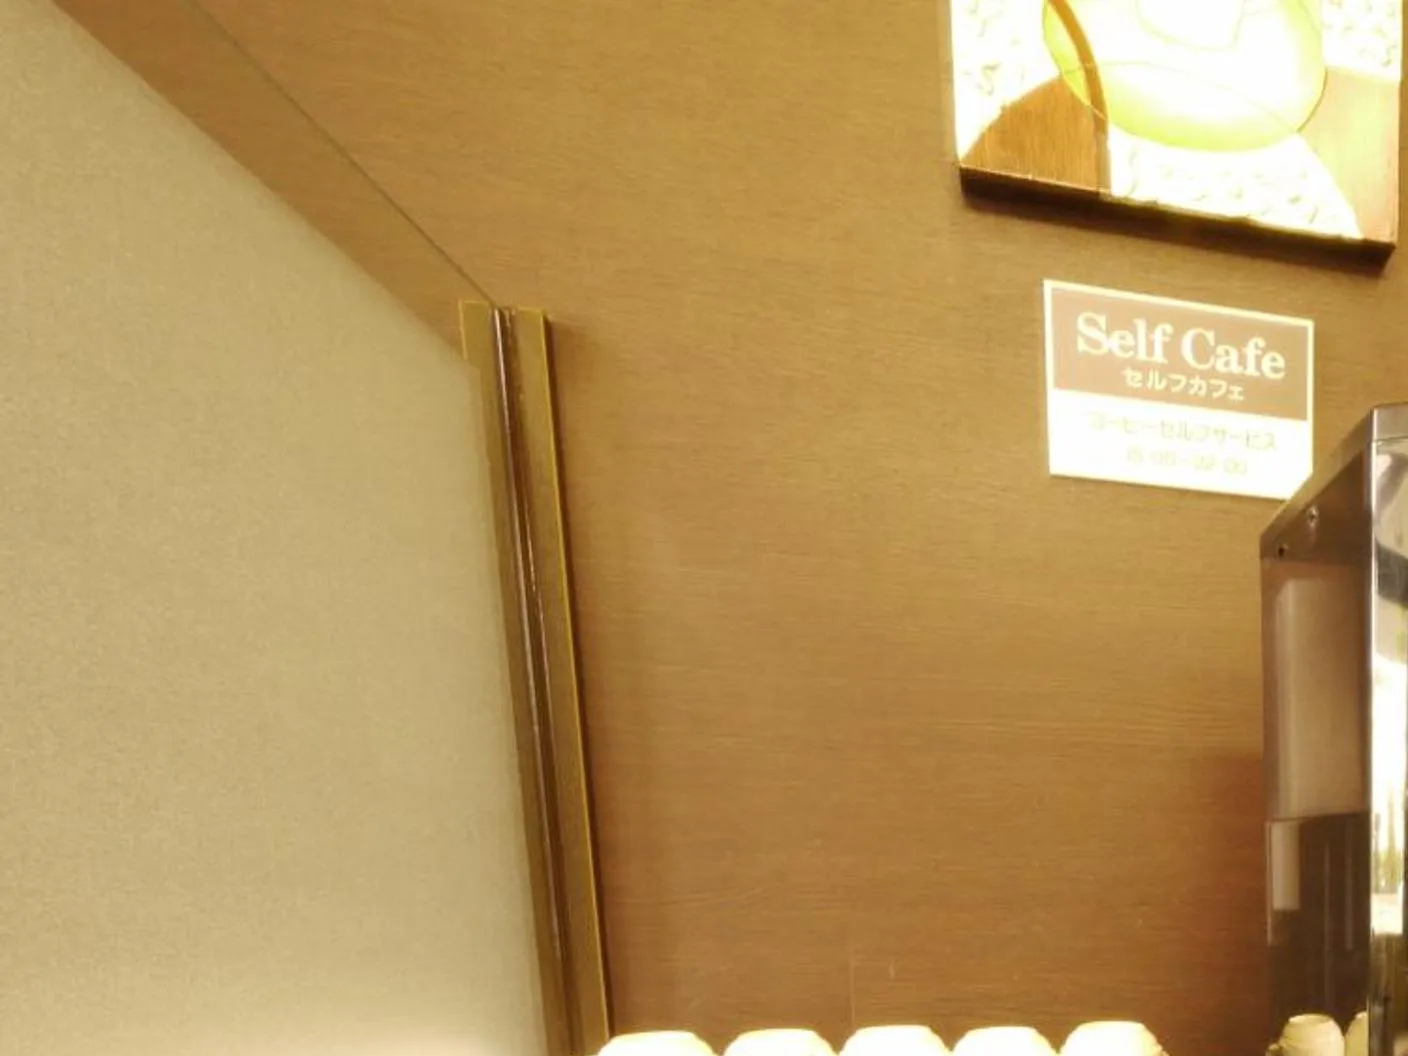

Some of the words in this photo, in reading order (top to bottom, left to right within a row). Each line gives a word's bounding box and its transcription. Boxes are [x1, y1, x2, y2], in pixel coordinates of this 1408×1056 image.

[1077, 311, 1173, 364] Self
[1181, 328, 1286, 379] Cafe
[1122, 367, 1245, 401] セルフカフェ
